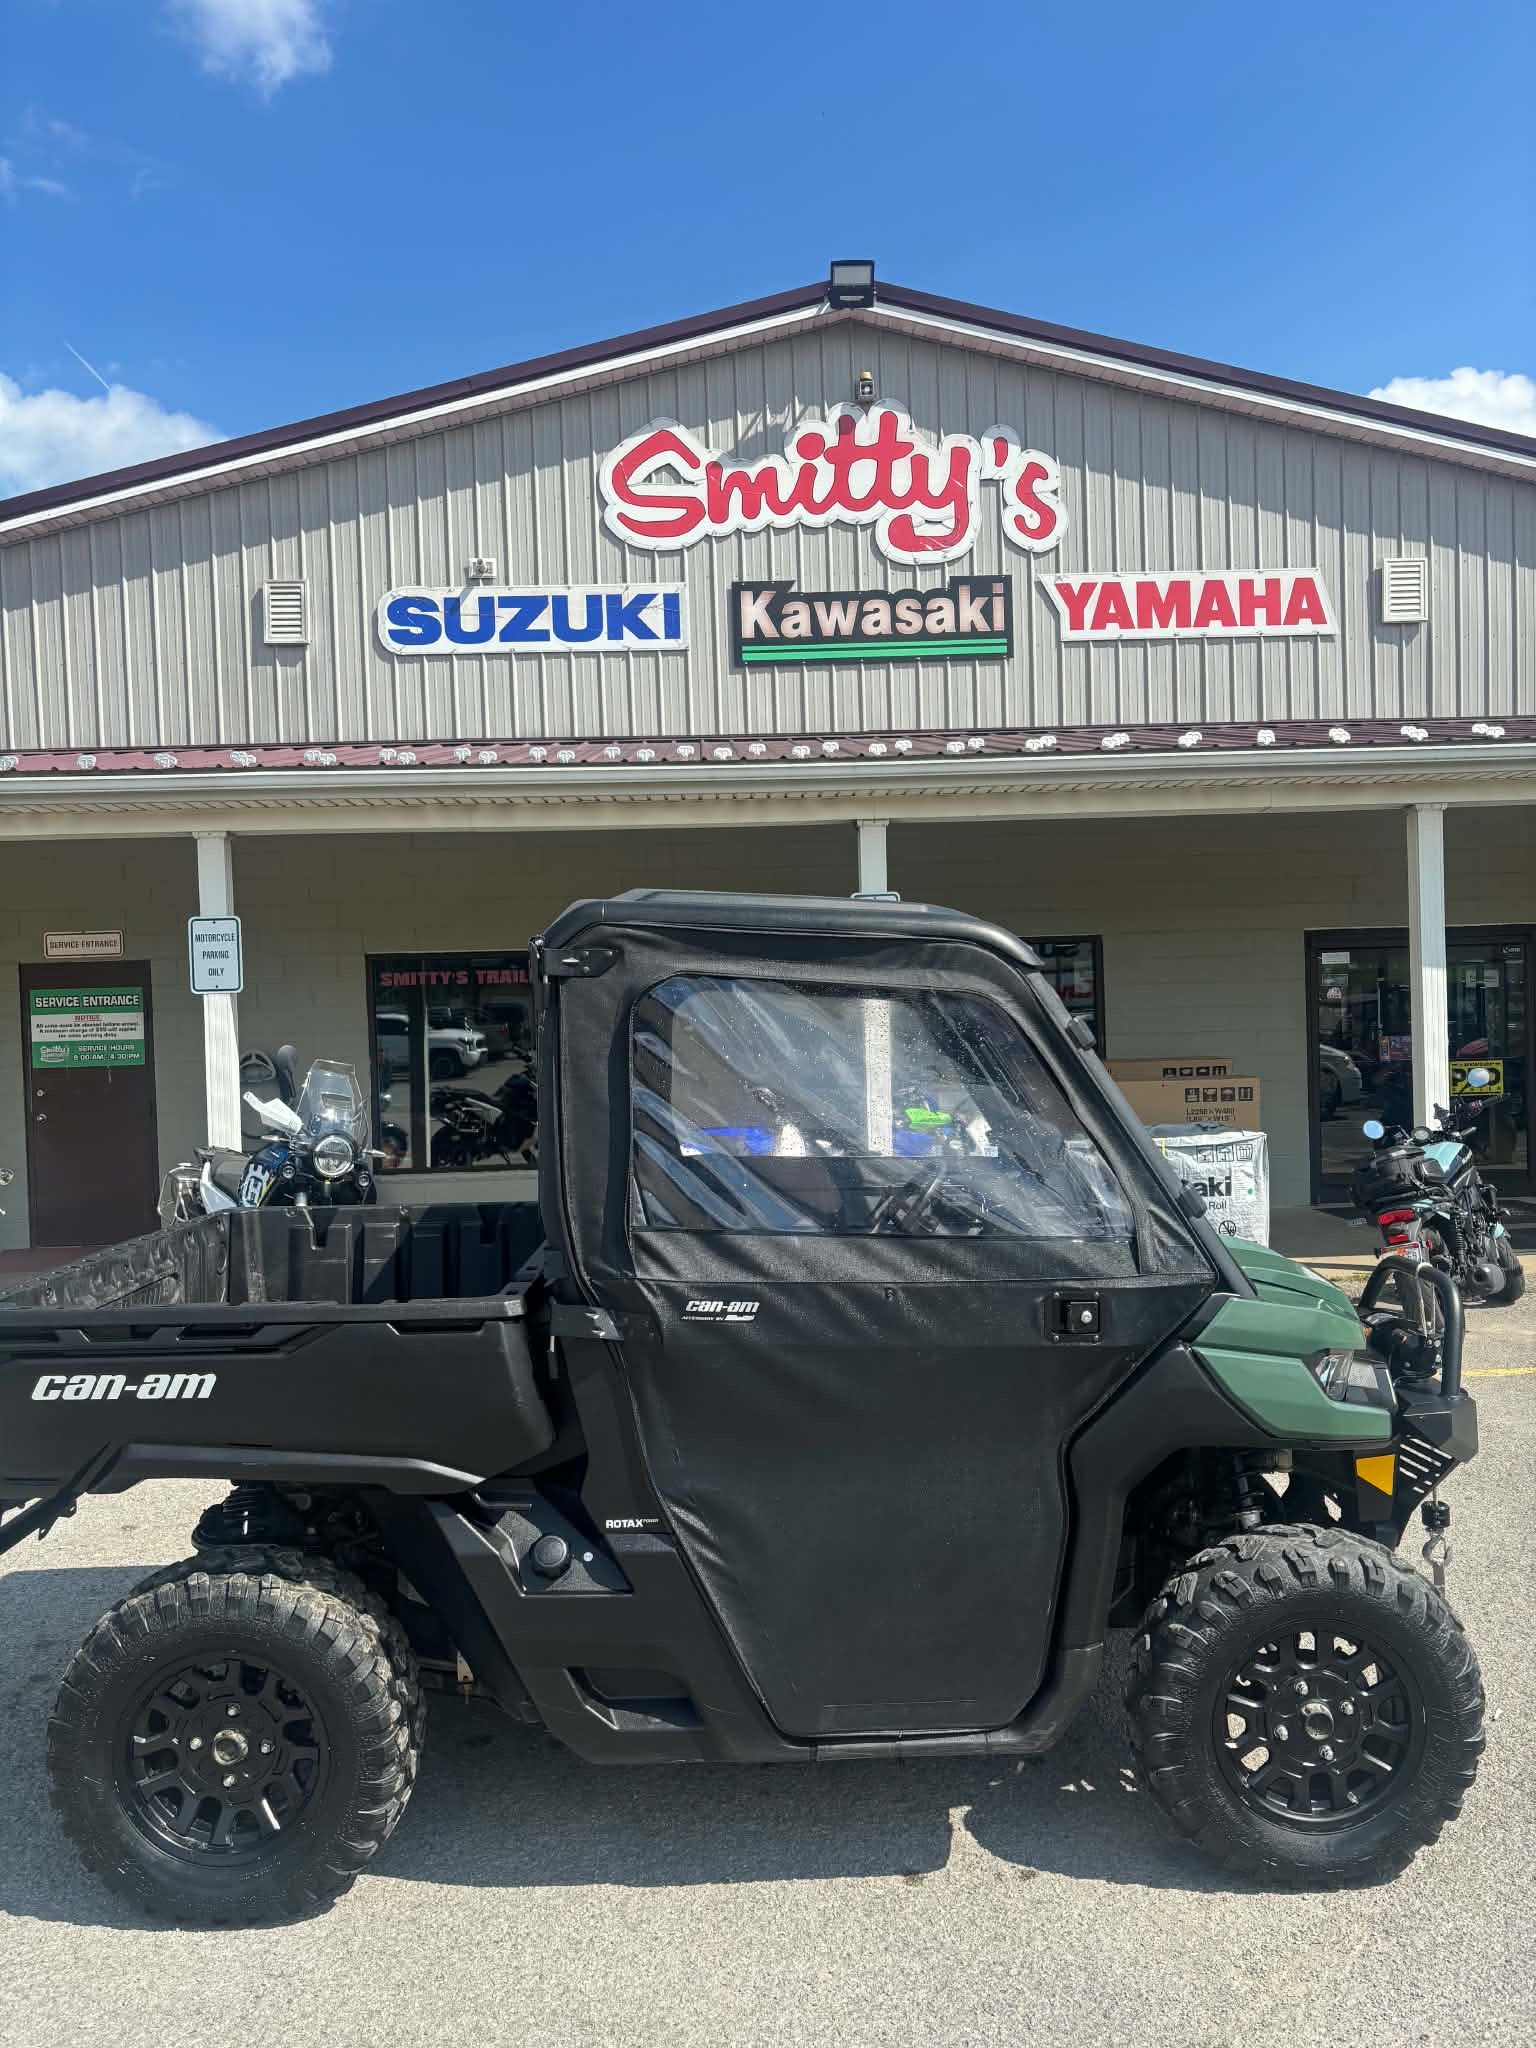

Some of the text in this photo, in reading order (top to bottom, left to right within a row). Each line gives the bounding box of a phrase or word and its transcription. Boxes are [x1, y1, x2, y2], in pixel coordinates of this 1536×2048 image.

[611, 410, 1057, 552] Smitty's
[739, 582, 1005, 640] Kawasaki
[1054, 577, 1328, 631] YAMAHA
[386, 592, 681, 646] SUZUKI
[49, 939, 118, 949] SERVICE ENTRANCE
[195, 933, 236, 943] MOTORCYCLE
[202, 950, 230, 960] PARKING
[208, 967, 225, 977] ONLY
[380, 970, 469, 987] SMITTY'S
[35, 994, 140, 1008] SERVICE ENTRANCE
[685, 1300, 760, 1313] can-am
[31, 1373, 217, 1401] can-am
[605, 1519, 643, 1529] ROTAX
